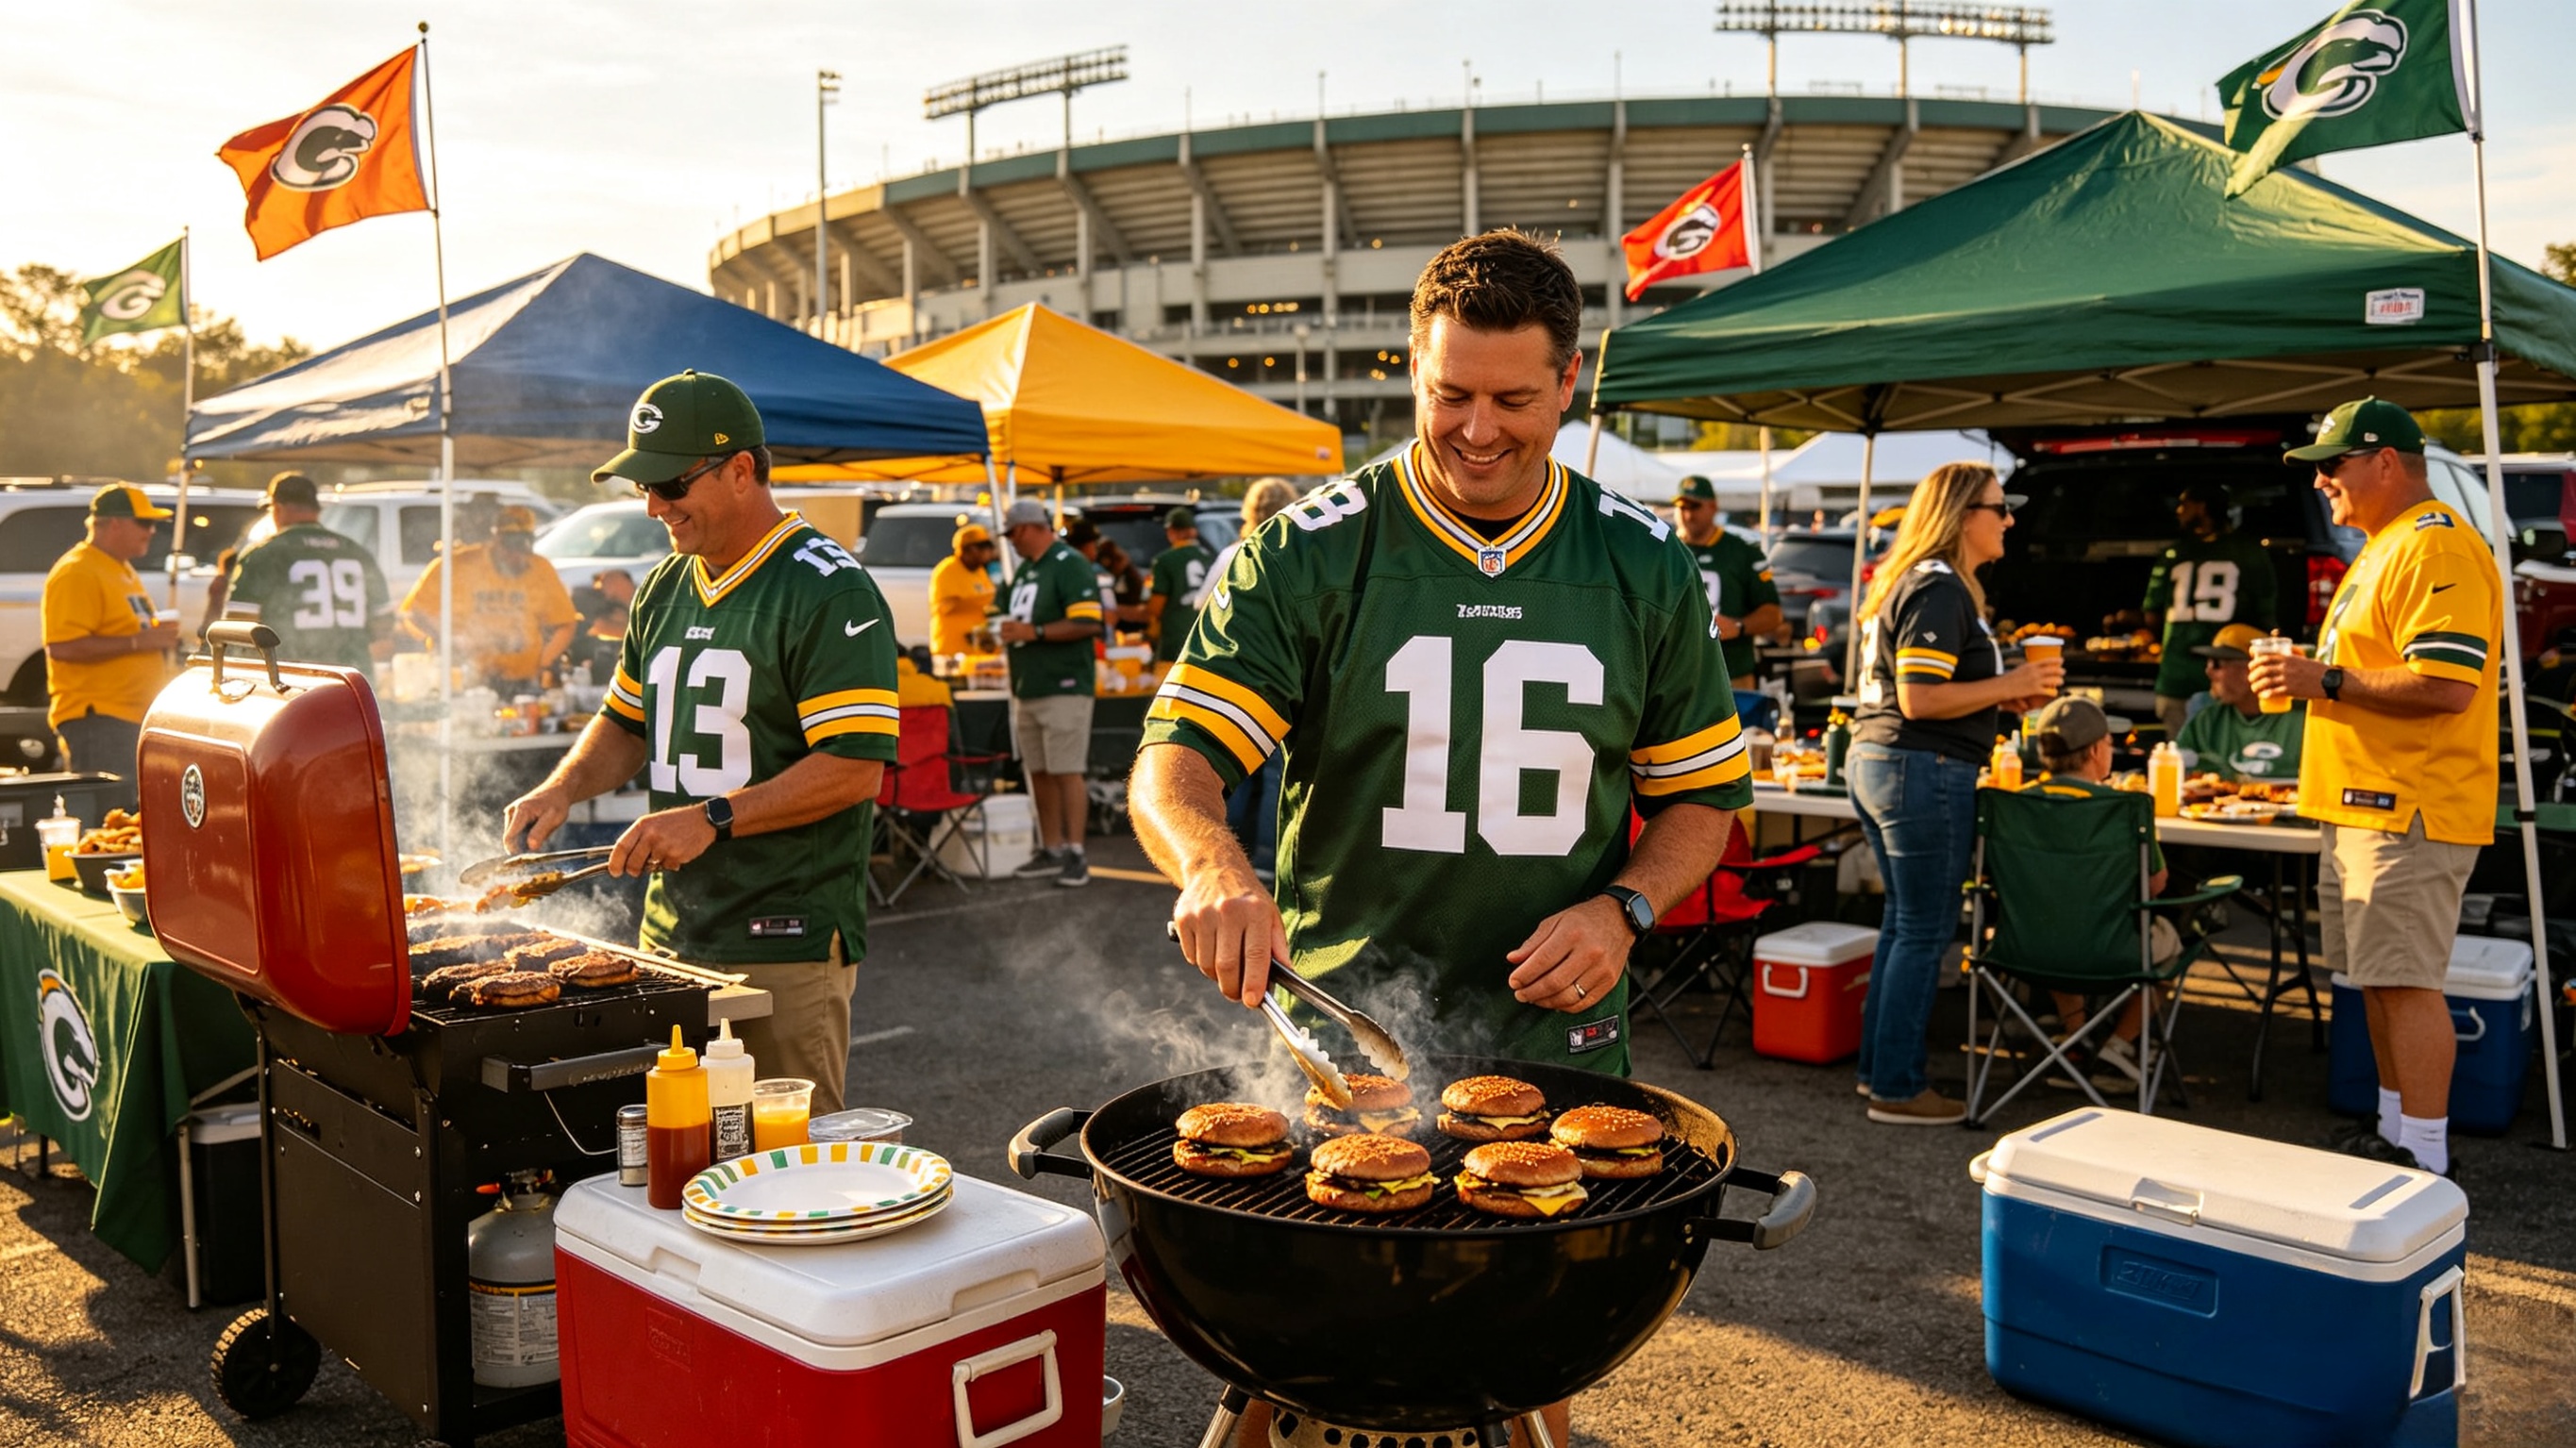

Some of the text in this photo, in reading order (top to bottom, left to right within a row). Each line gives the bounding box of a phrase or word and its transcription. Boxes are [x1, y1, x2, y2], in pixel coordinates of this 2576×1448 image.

[632, 403, 663, 434] G
[289, 558, 367, 629] 39
[647, 645, 752, 797] 13
[1381, 635, 1604, 856] 16
